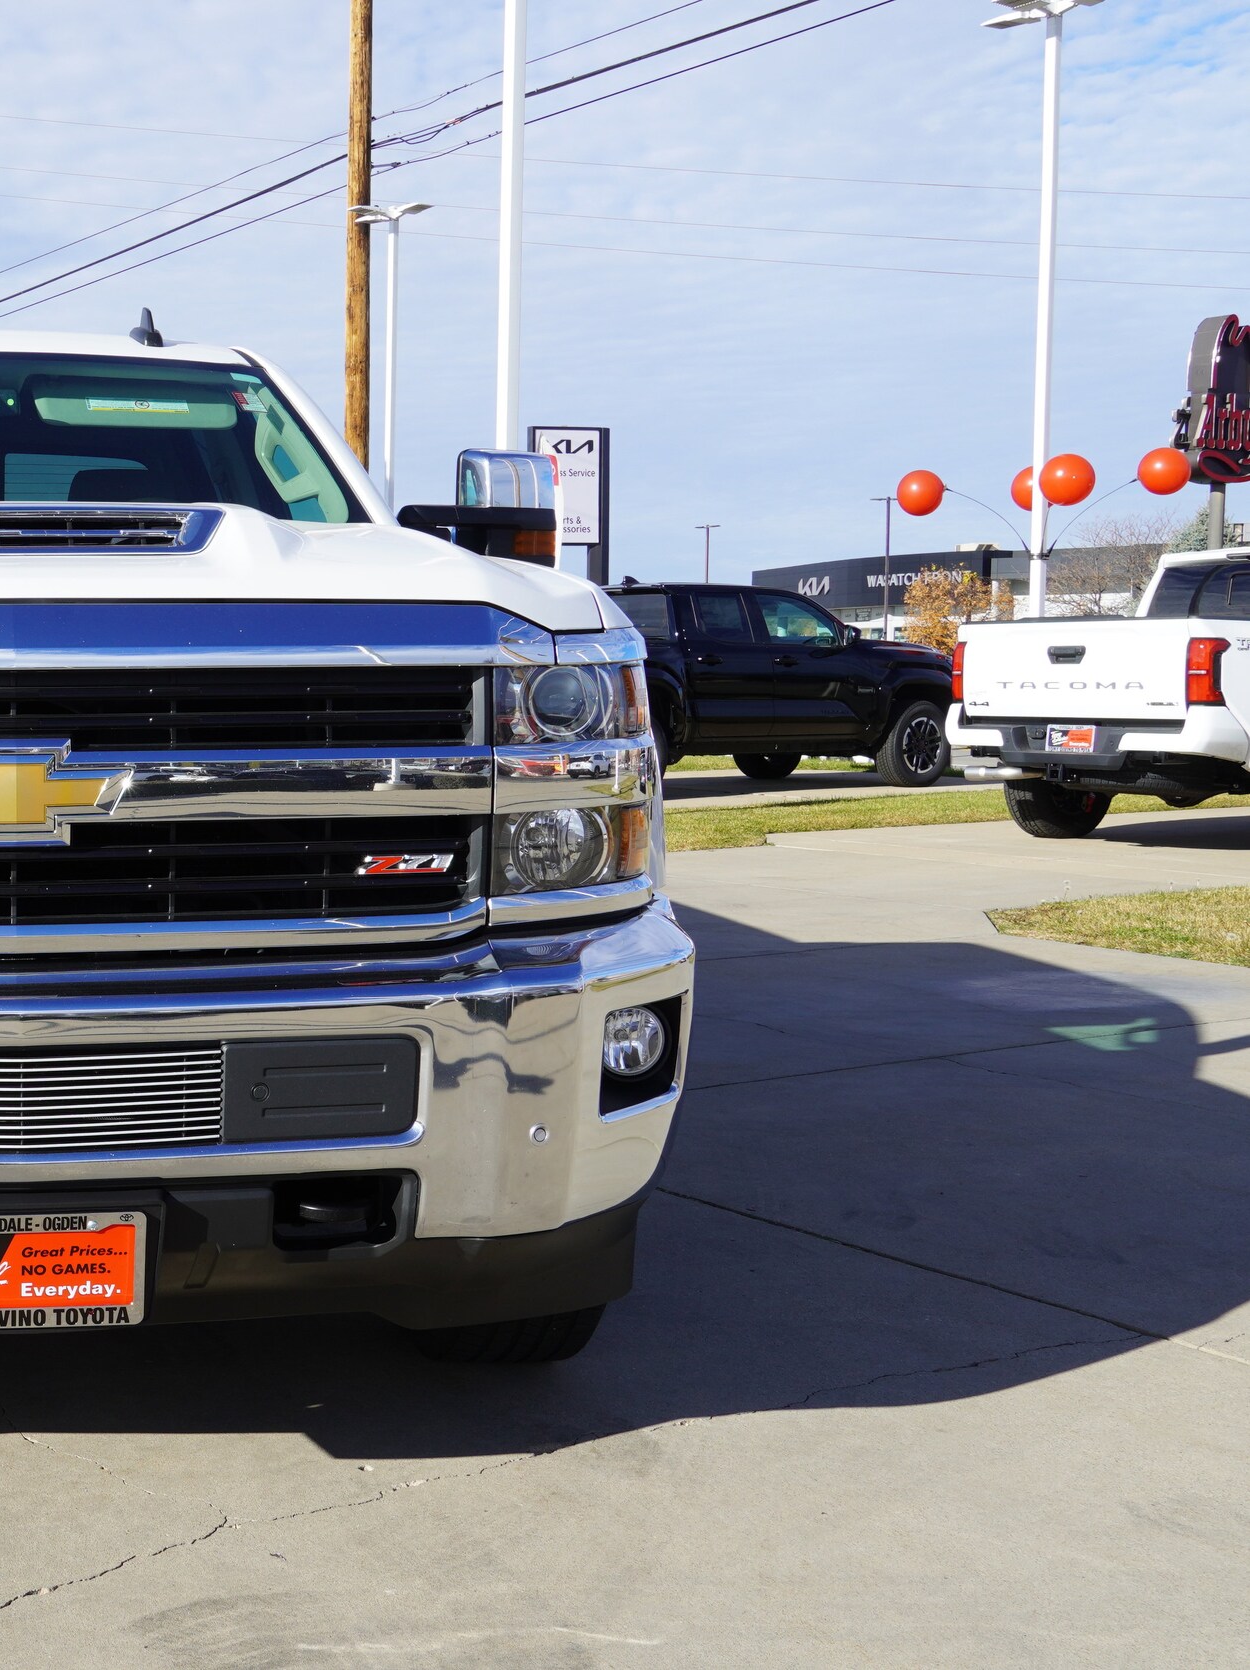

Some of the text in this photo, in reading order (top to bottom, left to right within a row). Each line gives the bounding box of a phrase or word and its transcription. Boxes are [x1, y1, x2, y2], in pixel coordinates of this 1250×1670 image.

[568, 468, 596, 477] Service
[576, 516, 582, 525] &
[562, 525, 591, 533] ssories
[798, 575, 830, 596] KIA
[996, 681, 1144, 690] TACOMA
[356, 853, 454, 875] Z71
[42, 1215, 88, 1232] OGDEN
[21, 1244, 128, 1259] Great Prices...
[21, 1263, 111, 1276] NO GAMES.
[20, 1281, 121, 1299] Everyday.
[53, 1306, 130, 1326] TOYOTA
